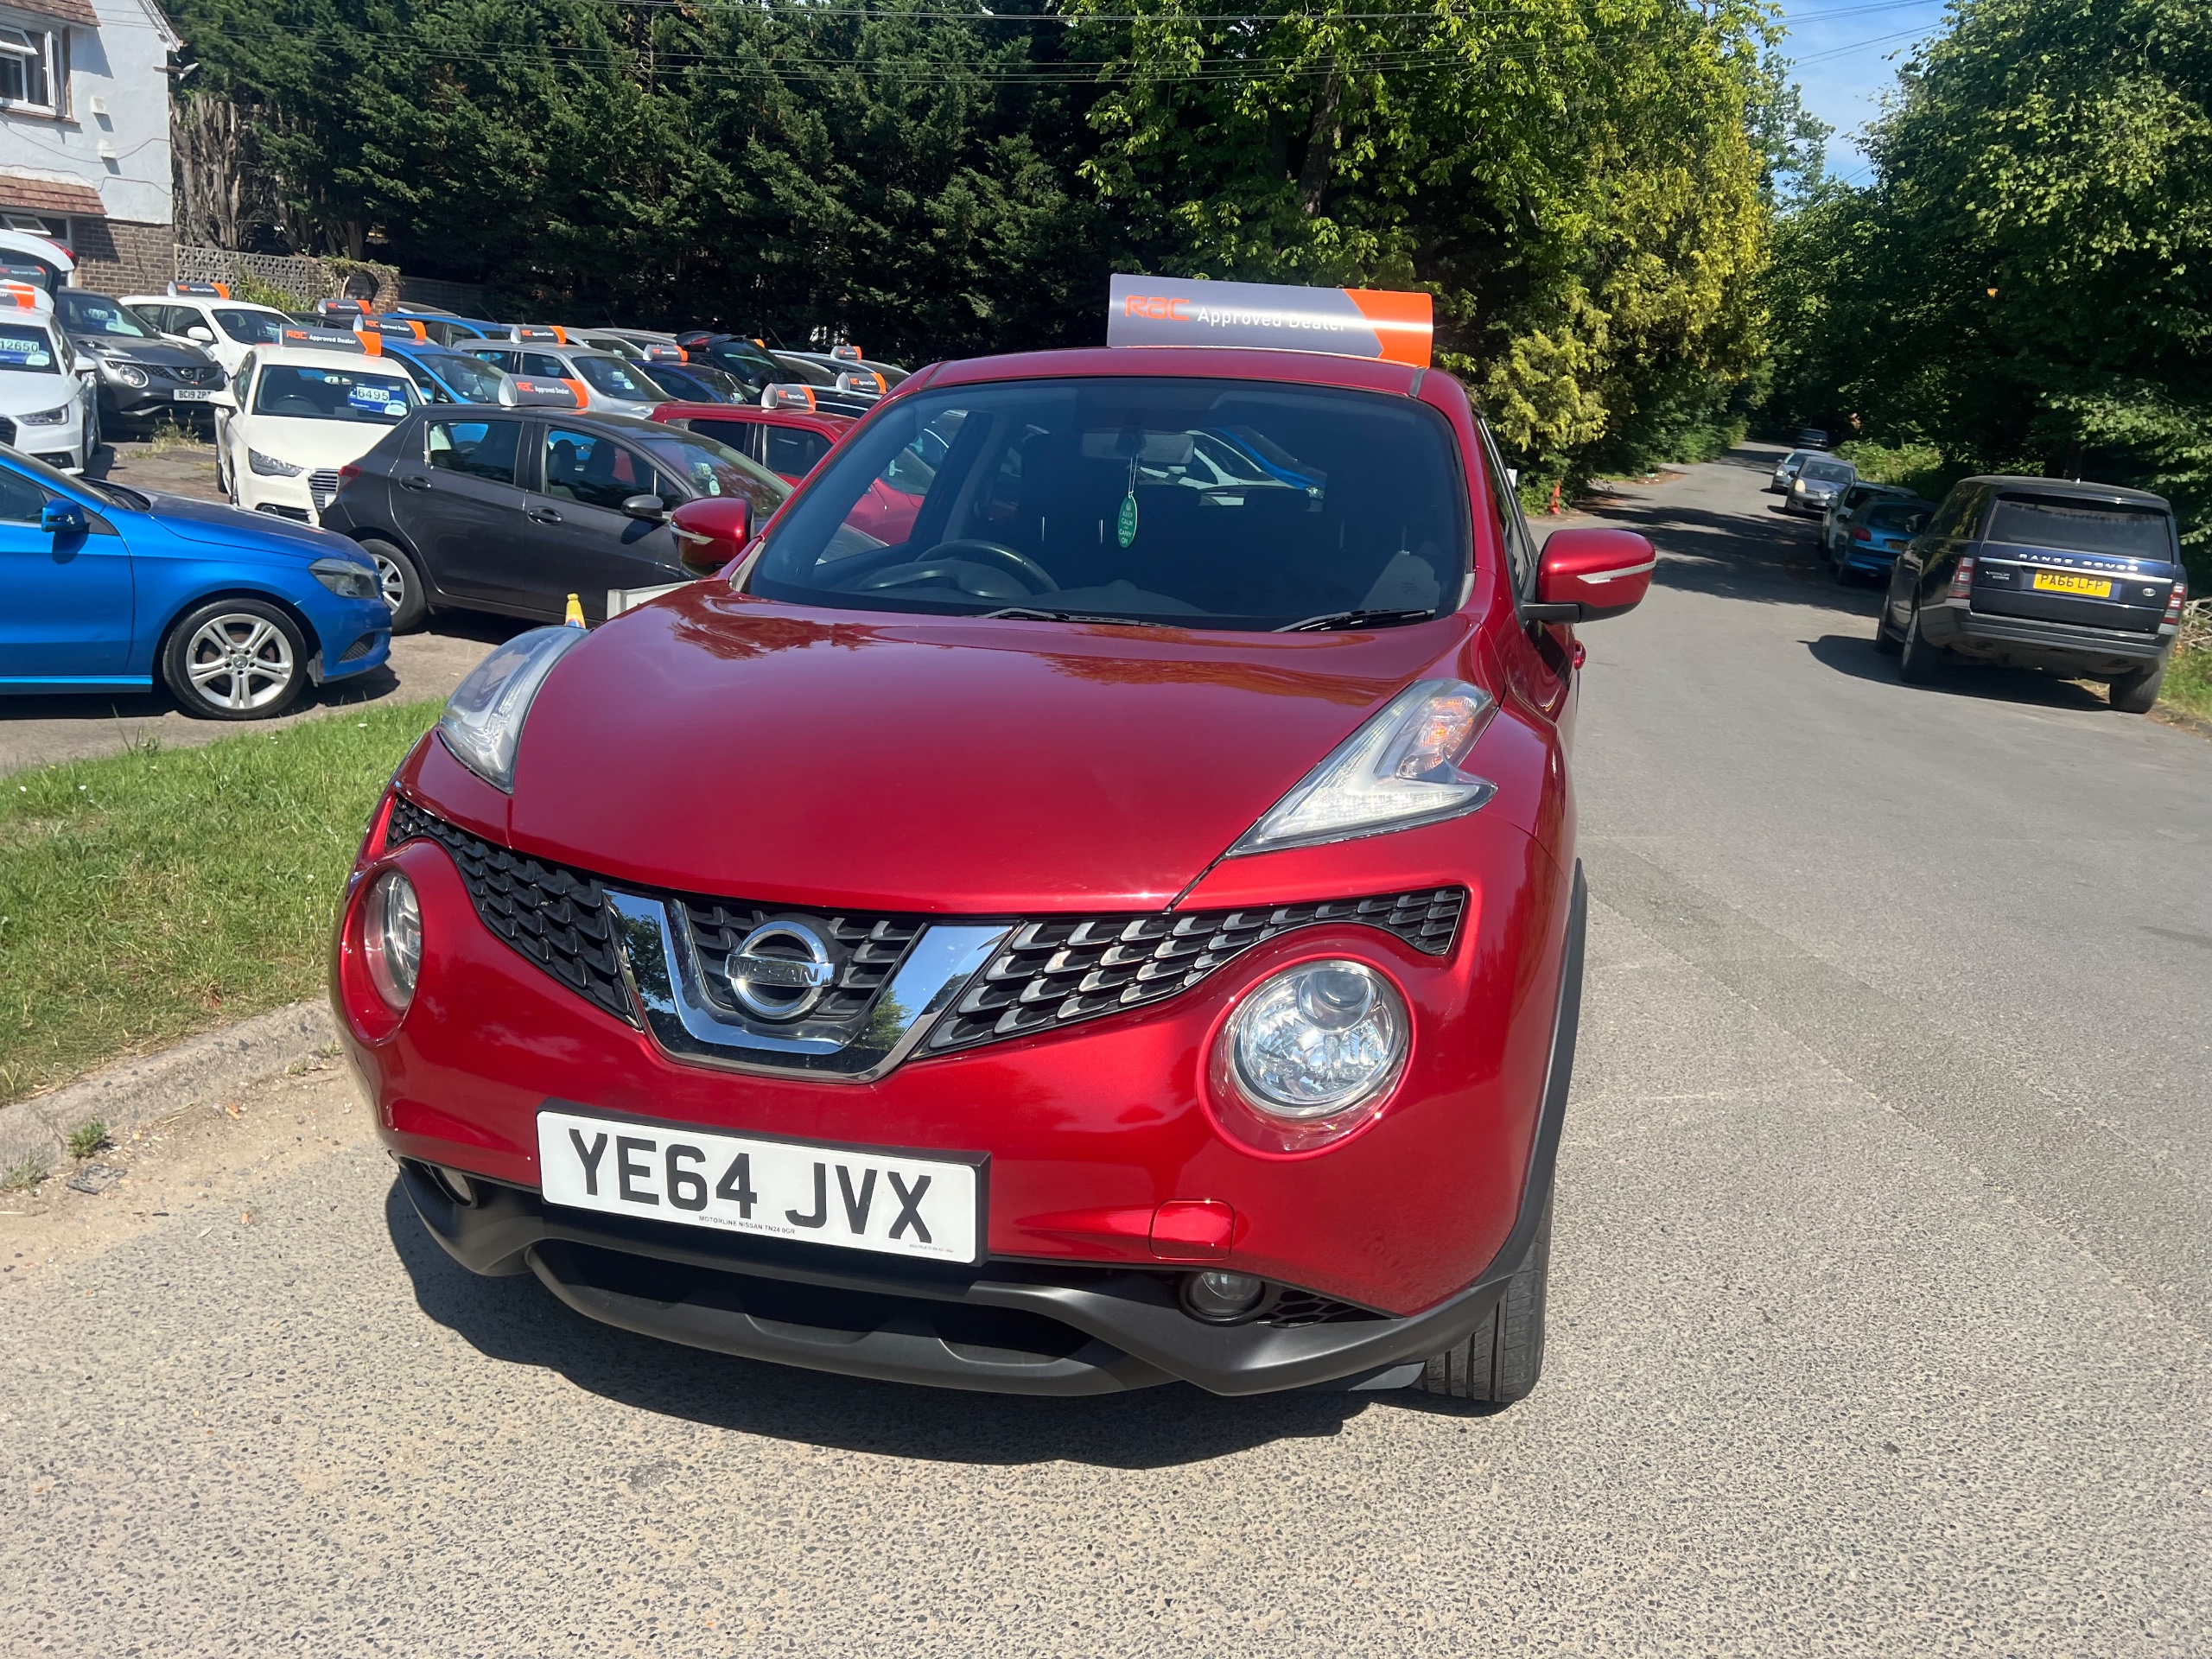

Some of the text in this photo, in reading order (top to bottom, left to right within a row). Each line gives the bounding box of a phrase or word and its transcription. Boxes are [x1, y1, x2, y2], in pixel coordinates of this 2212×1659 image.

[1197, 307, 1283, 327] Approved
[1288, 315, 1345, 331] Dealer
[308, 334, 336, 343] Approved
[2019, 553, 2074, 564] RANGE
[2039, 574, 2074, 588] PA66
[732, 959, 818, 983] NISSAN
[569, 1128, 932, 1243] YE64 JVX
[698, 1215, 737, 1226] MOTORLINE
[738, 1221, 763, 1230] NISSAN
[765, 1224, 780, 1233] TN24
